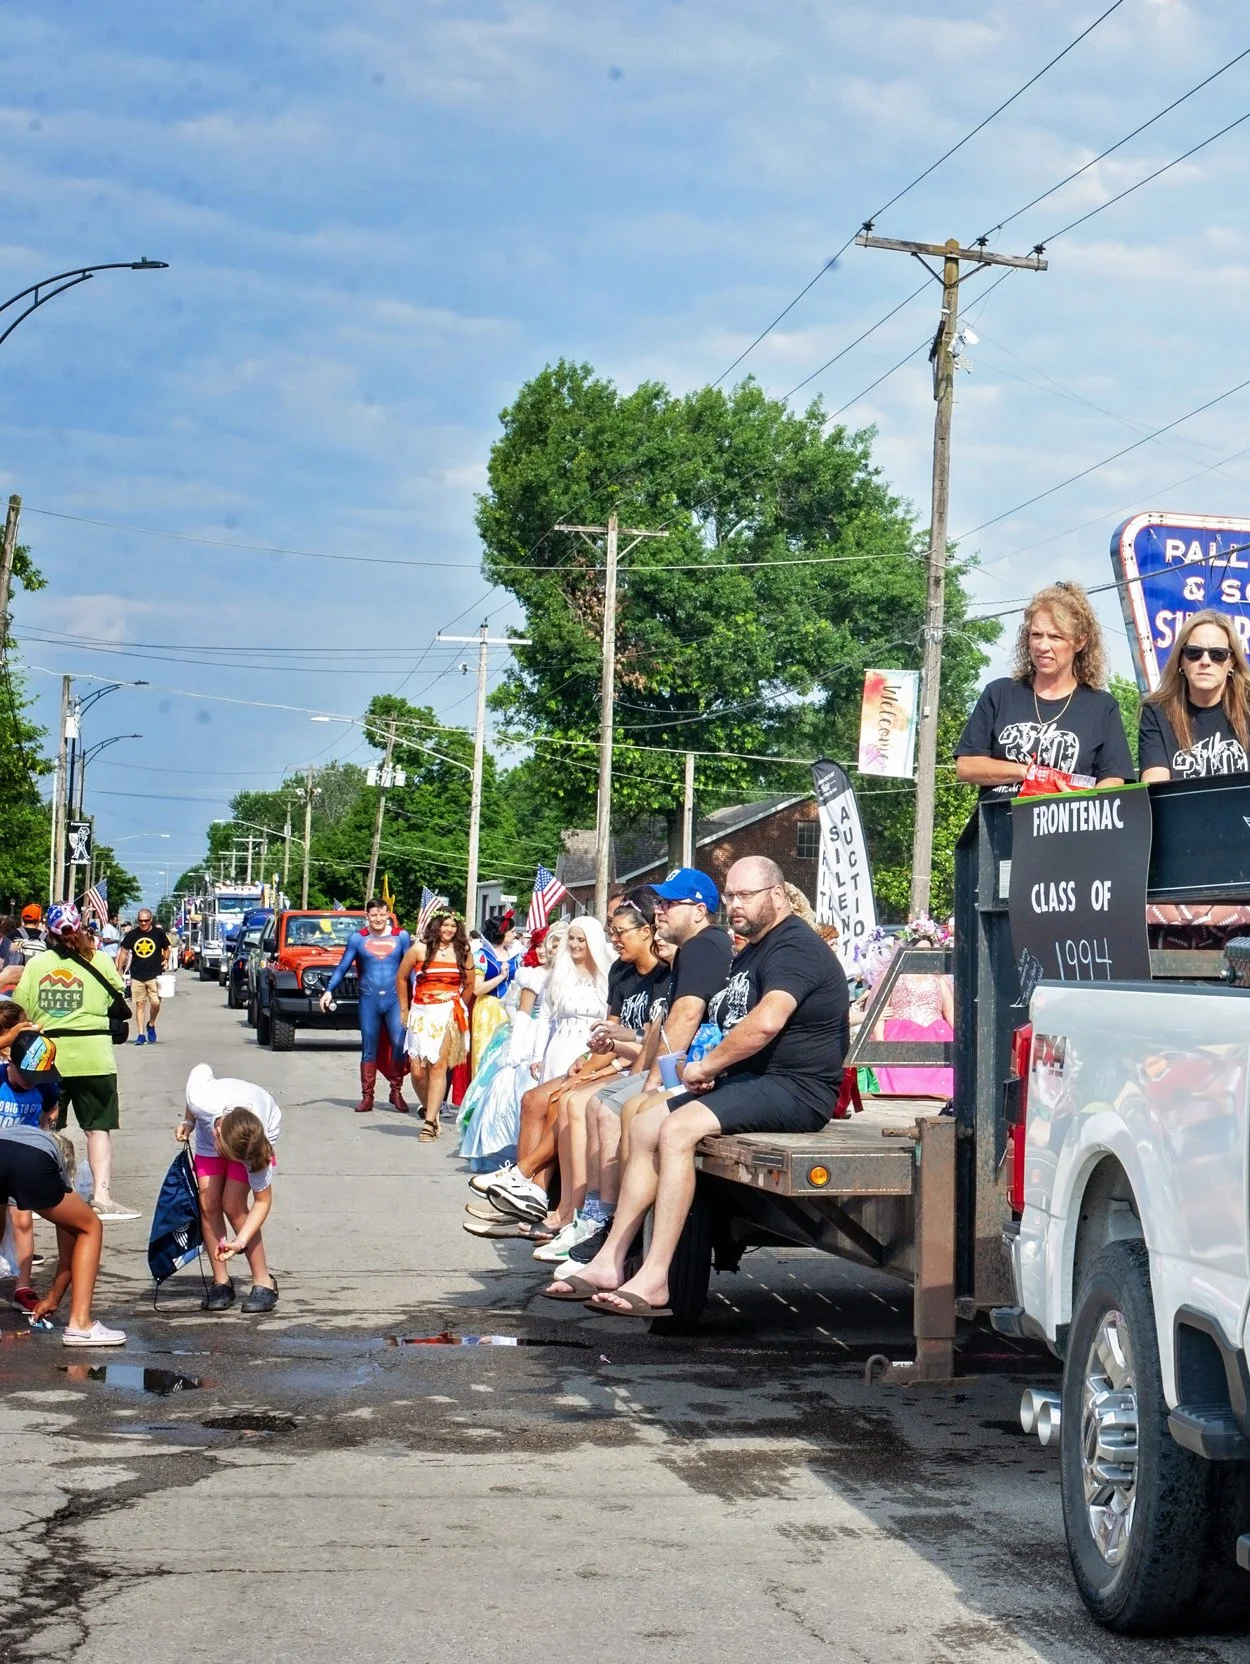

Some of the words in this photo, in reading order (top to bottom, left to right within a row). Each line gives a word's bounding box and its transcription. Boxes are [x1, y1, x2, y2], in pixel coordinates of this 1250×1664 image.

[1183, 577, 1205, 601] &
[876, 686, 901, 760] Welcome
[1033, 798, 1124, 837] FRONTENAC
[840, 805, 865, 937] AUCTIO
[829, 825, 850, 956] SILENT
[1031, 881, 1076, 914] CLASS
[1091, 880, 1112, 912] OF
[1055, 937, 1113, 981] 1994
[41, 991, 80, 1000] BLACK
[41, 1000, 78, 1008] HILLS
[5, 1101, 19, 1114] BIG
